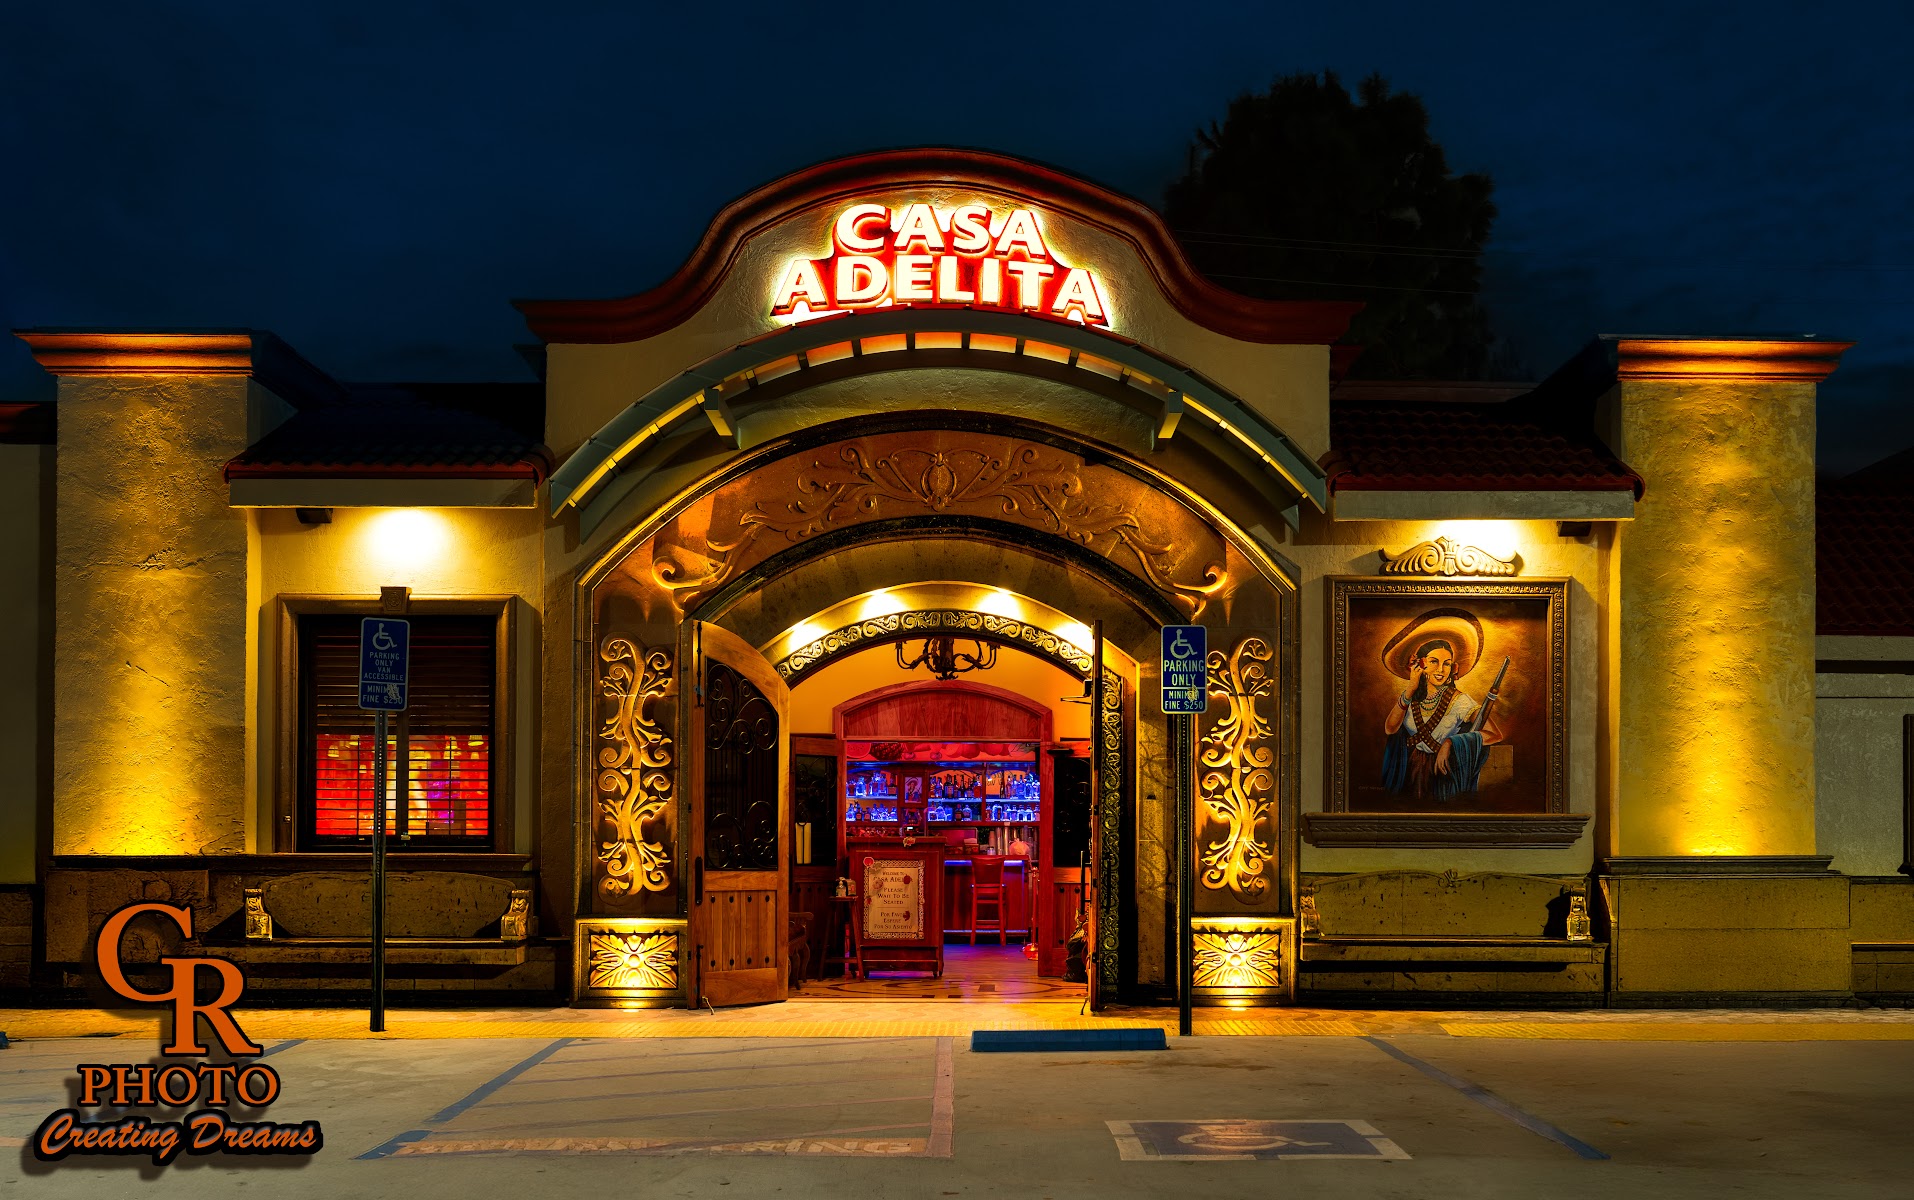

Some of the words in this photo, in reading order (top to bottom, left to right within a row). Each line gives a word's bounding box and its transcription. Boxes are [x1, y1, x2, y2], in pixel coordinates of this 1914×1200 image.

[836, 203, 1046, 259] CASA
[771, 254, 1108, 324] ADELITA
[369, 652, 400, 660] PARKING
[375, 659, 394, 667] ONLY
[1163, 660, 1205, 672] PARKING
[363, 673, 404, 681] ACCESSIBLE
[1171, 673, 1197, 686] ONLY
[362, 695, 380, 703] FINE
[1164, 700, 1181, 710] FINE
[1183, 700, 1204, 710] $250
